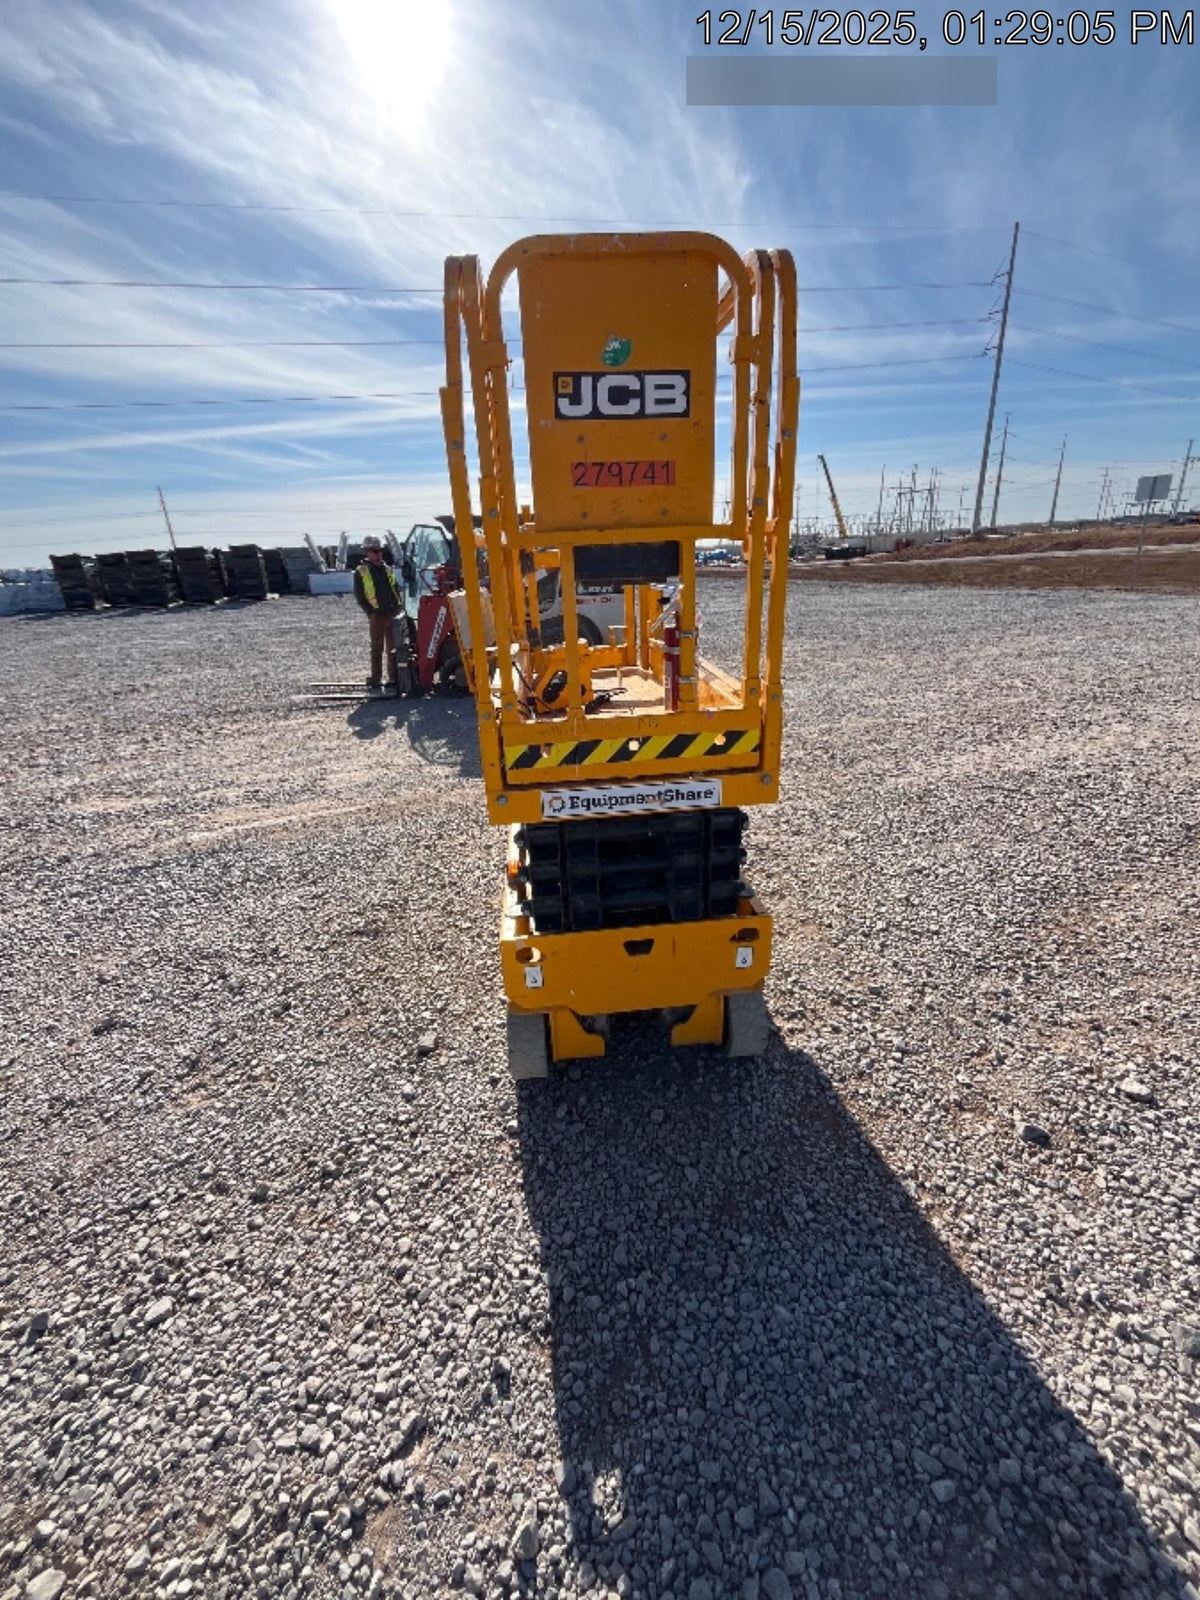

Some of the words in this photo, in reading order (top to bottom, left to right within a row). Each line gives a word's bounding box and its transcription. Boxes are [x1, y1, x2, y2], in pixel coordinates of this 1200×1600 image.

[558, 374, 687, 416] JCB
[573, 461, 671, 487] 279741
[568, 788, 715, 811] EquipmentShare
